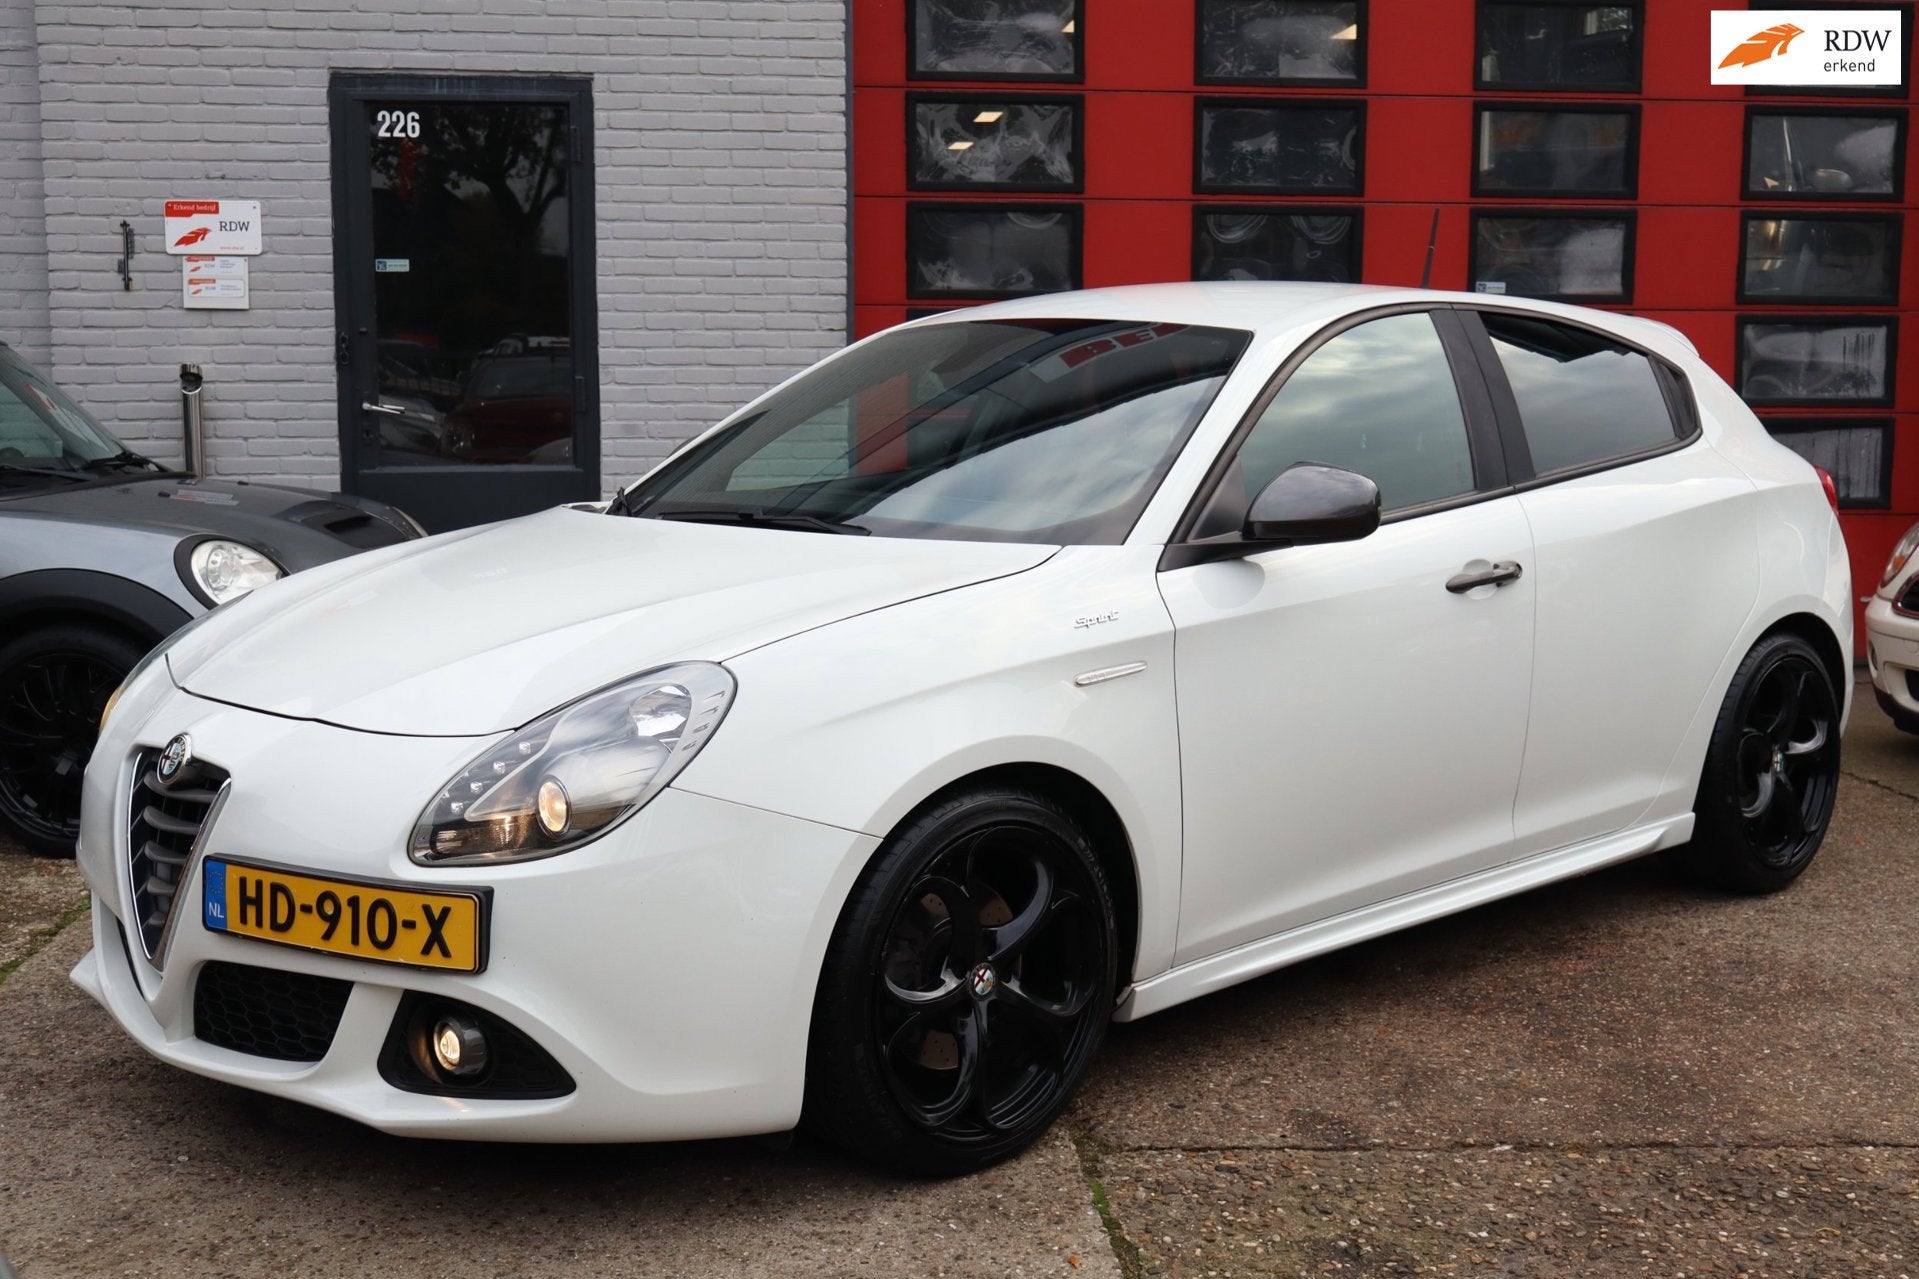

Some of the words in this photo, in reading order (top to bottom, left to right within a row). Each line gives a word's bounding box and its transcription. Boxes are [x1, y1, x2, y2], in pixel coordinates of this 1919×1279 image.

[377, 110, 421, 138] 226
[173, 203, 195, 211] Erkend
[219, 221, 250, 232] RDW
[1074, 611, 1120, 629] Sprint
[208, 902, 225, 919] NL
[238, 875, 452, 959] HD-910-X
